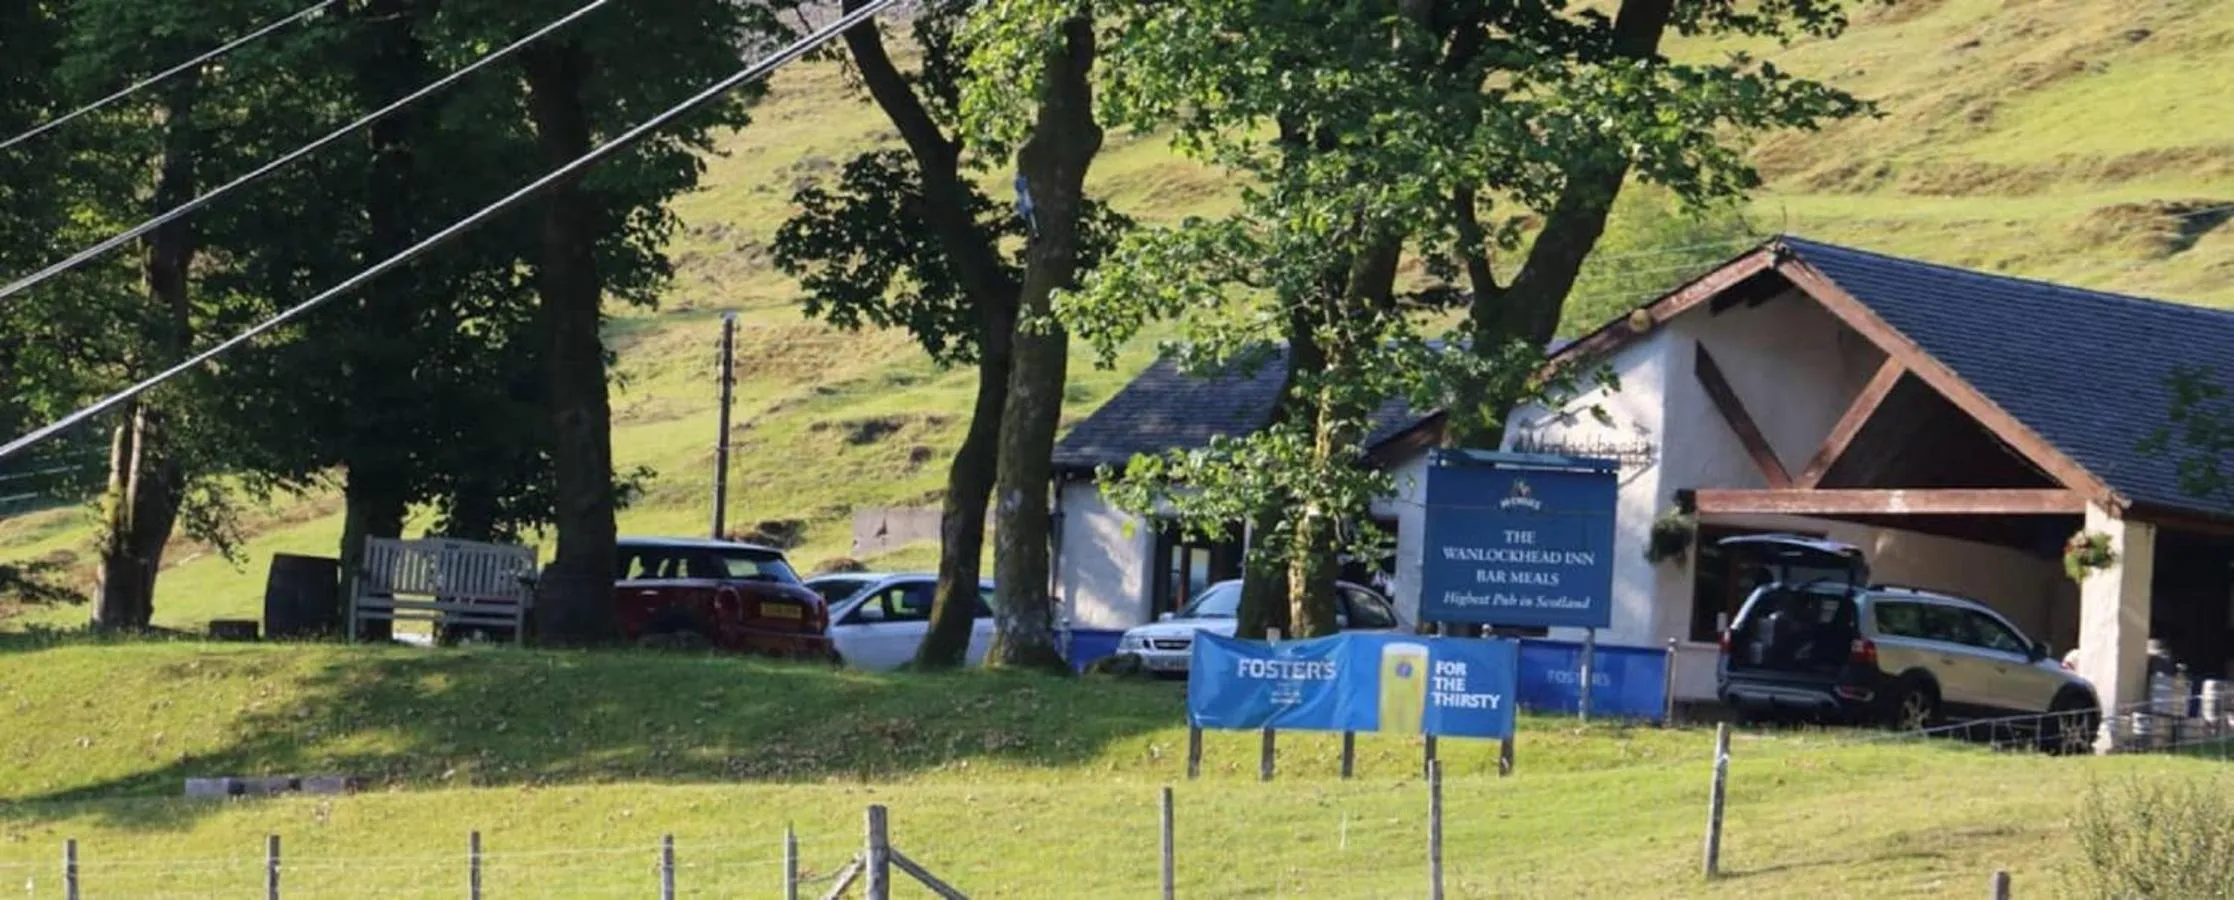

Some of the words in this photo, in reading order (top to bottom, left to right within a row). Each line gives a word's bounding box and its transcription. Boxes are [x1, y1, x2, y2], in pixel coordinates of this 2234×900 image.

[1504, 530, 1536, 544] THE
[1443, 547, 1561, 564] WANLOCKHEAD
[1565, 551, 1595, 565] INN
[1476, 569, 1506, 583] BAR
[1510, 572, 1560, 586] MEALS
[1443, 591, 1490, 608] Highest
[1493, 592, 1518, 606] Pub
[1519, 595, 1533, 606] in
[1535, 594, 1590, 609] Scotland
[1237, 658, 1337, 680] FOSTER'S
[1435, 661, 1467, 676] FOR
[1433, 677, 1466, 692] THE
[1431, 692, 1500, 709] THIRSTY
